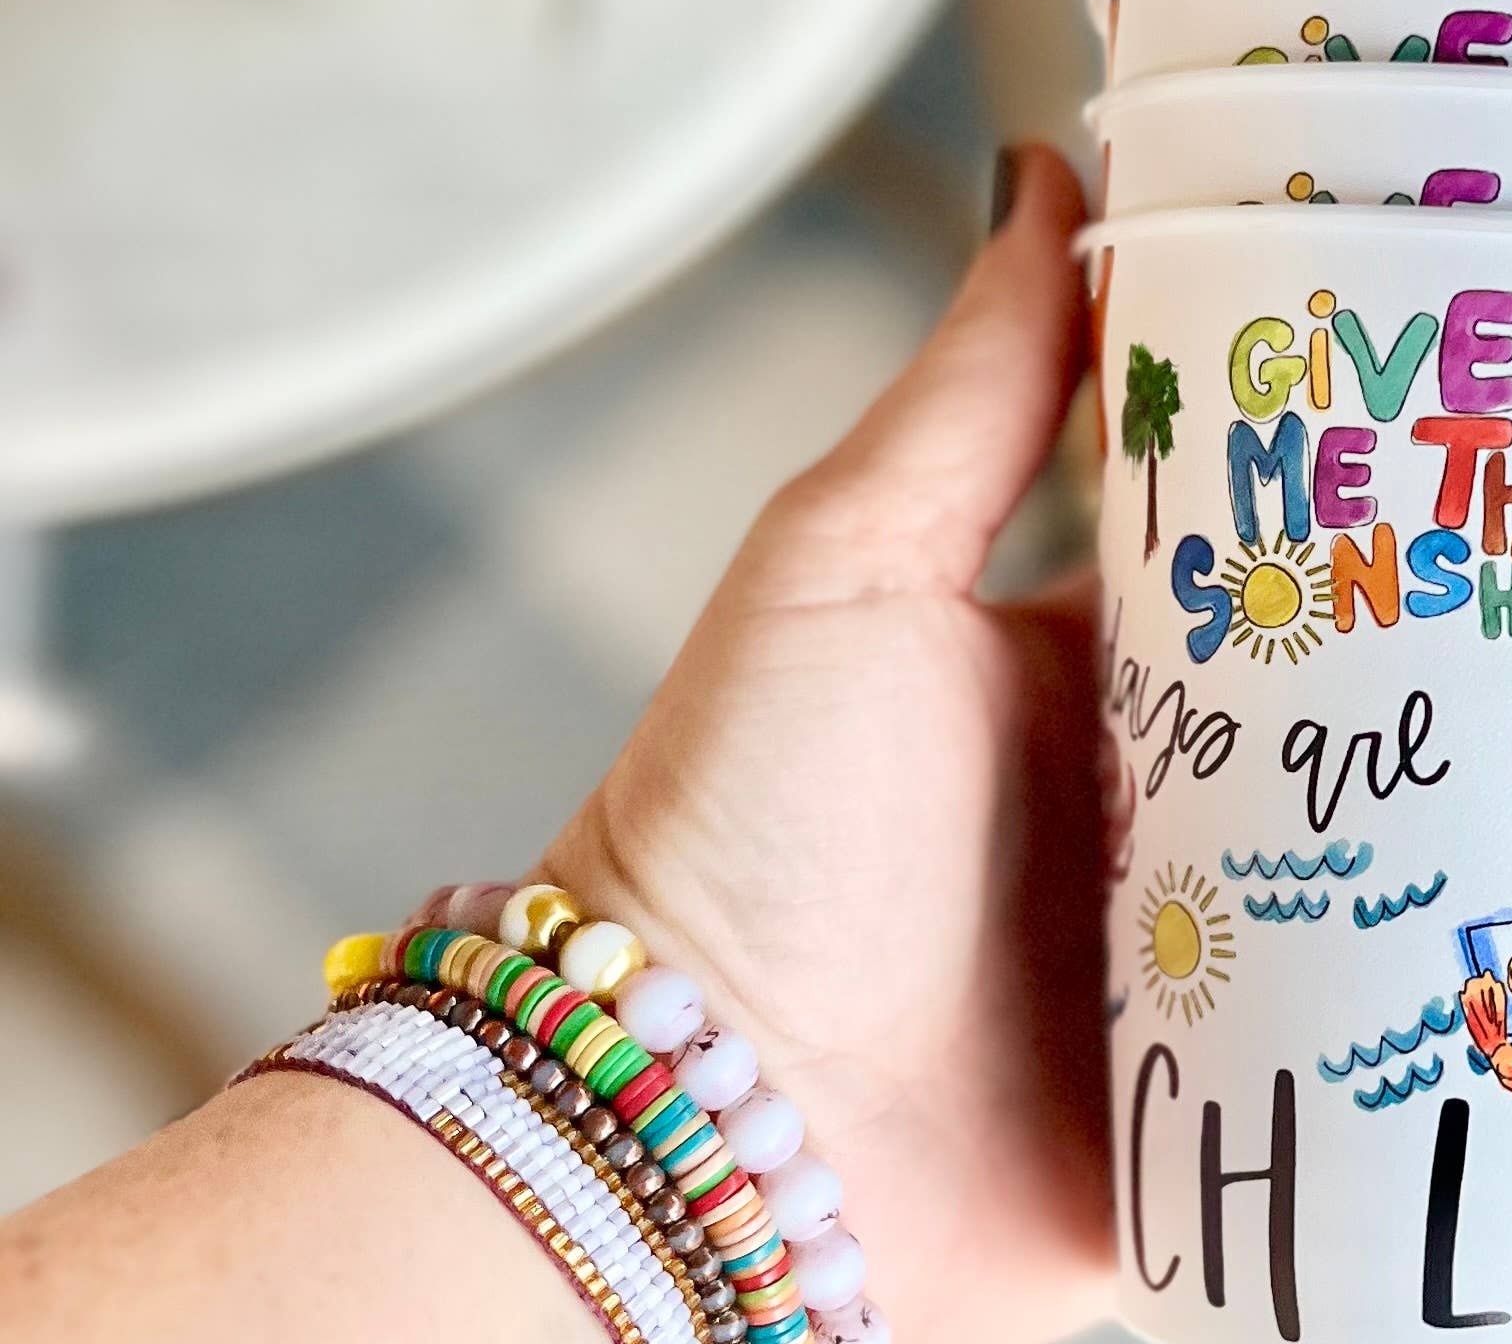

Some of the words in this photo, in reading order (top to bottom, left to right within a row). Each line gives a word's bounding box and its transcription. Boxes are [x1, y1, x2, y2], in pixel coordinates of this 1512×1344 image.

[1226, 410, 1378, 544] ME
[1281, 690, 1452, 834] are
[1129, 1042, 1302, 1343] CH
